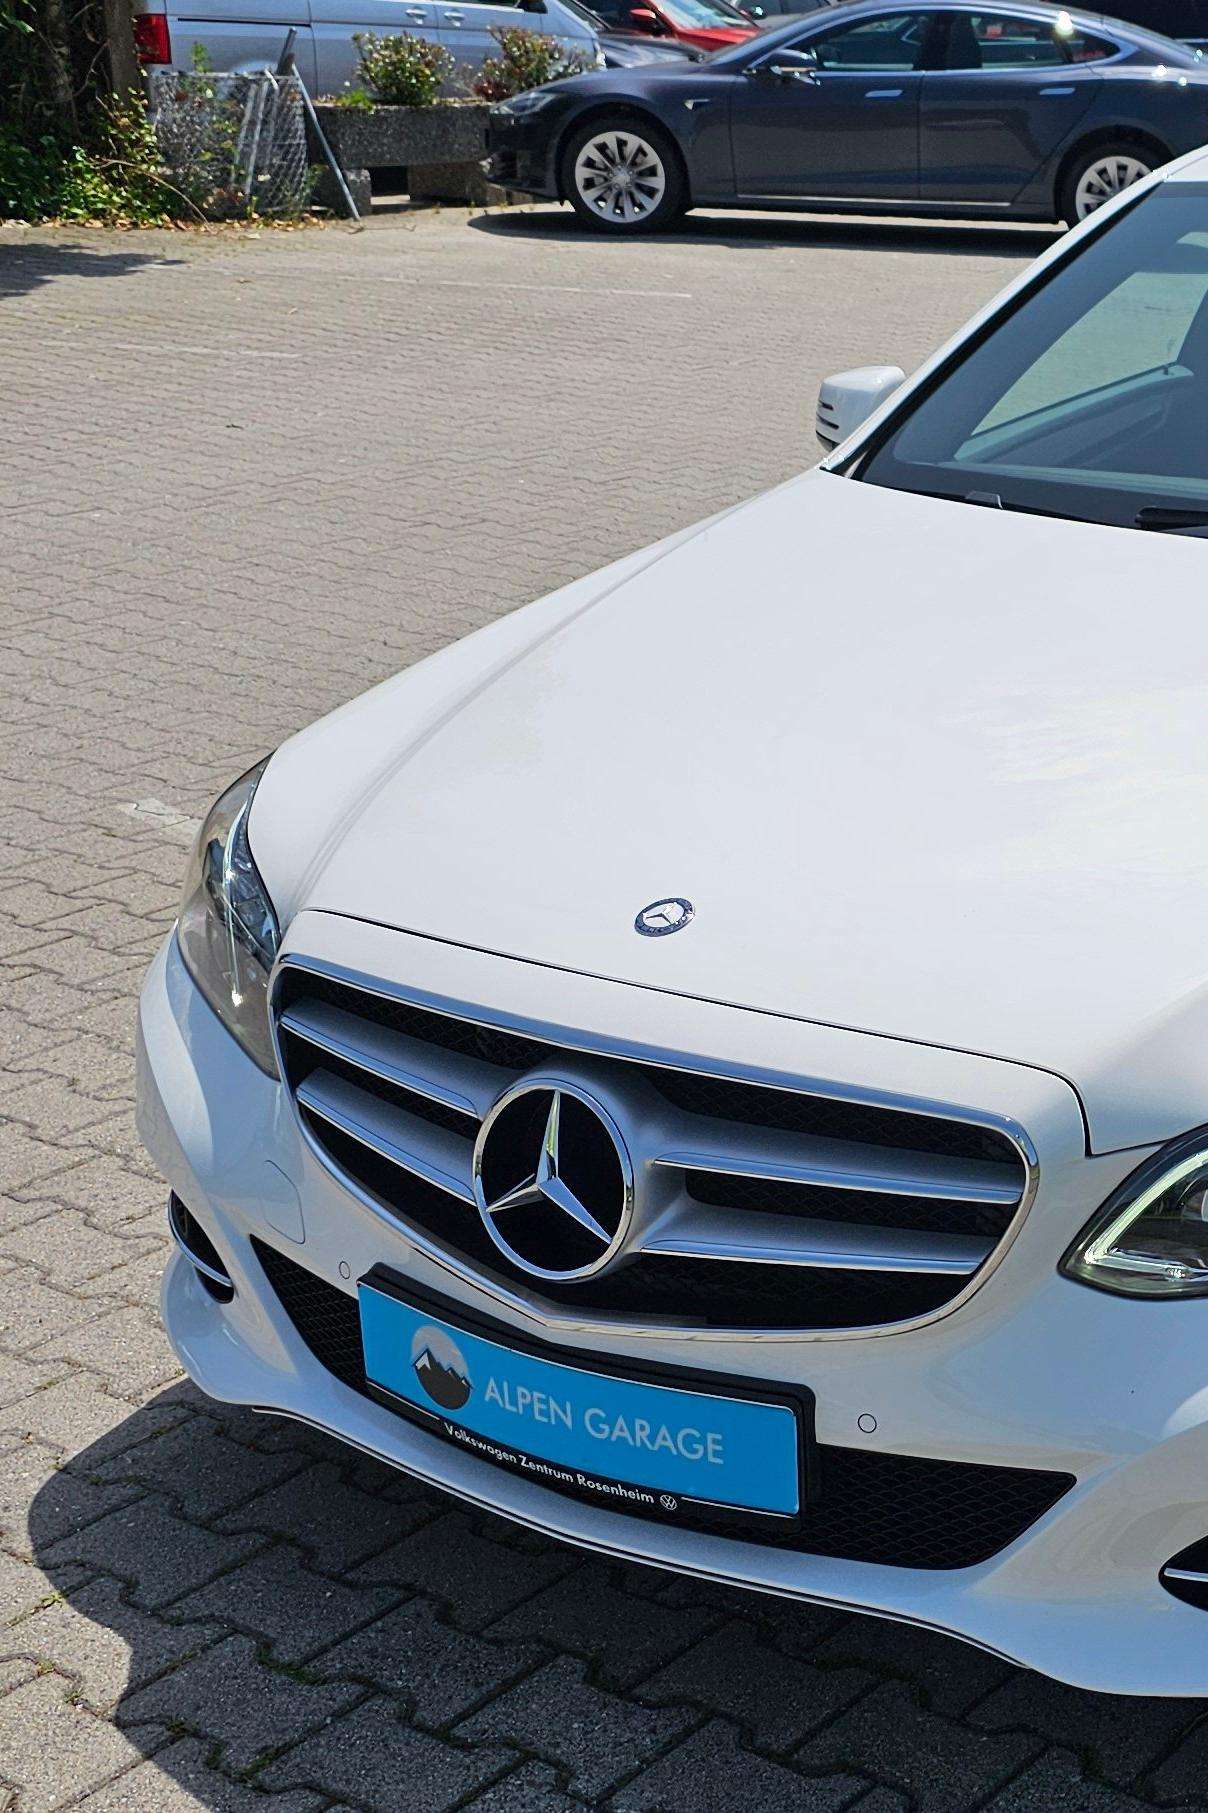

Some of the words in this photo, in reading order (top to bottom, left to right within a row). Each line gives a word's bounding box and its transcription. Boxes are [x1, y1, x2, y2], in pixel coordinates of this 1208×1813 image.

[444, 1421, 518, 1465] Volkswagen
[518, 1453, 574, 1483] Zentrum
[576, 1472, 655, 1504] Rosenheim
[484, 1376, 573, 1430] ALPEN
[583, 1406, 725, 1465] GARAGE
